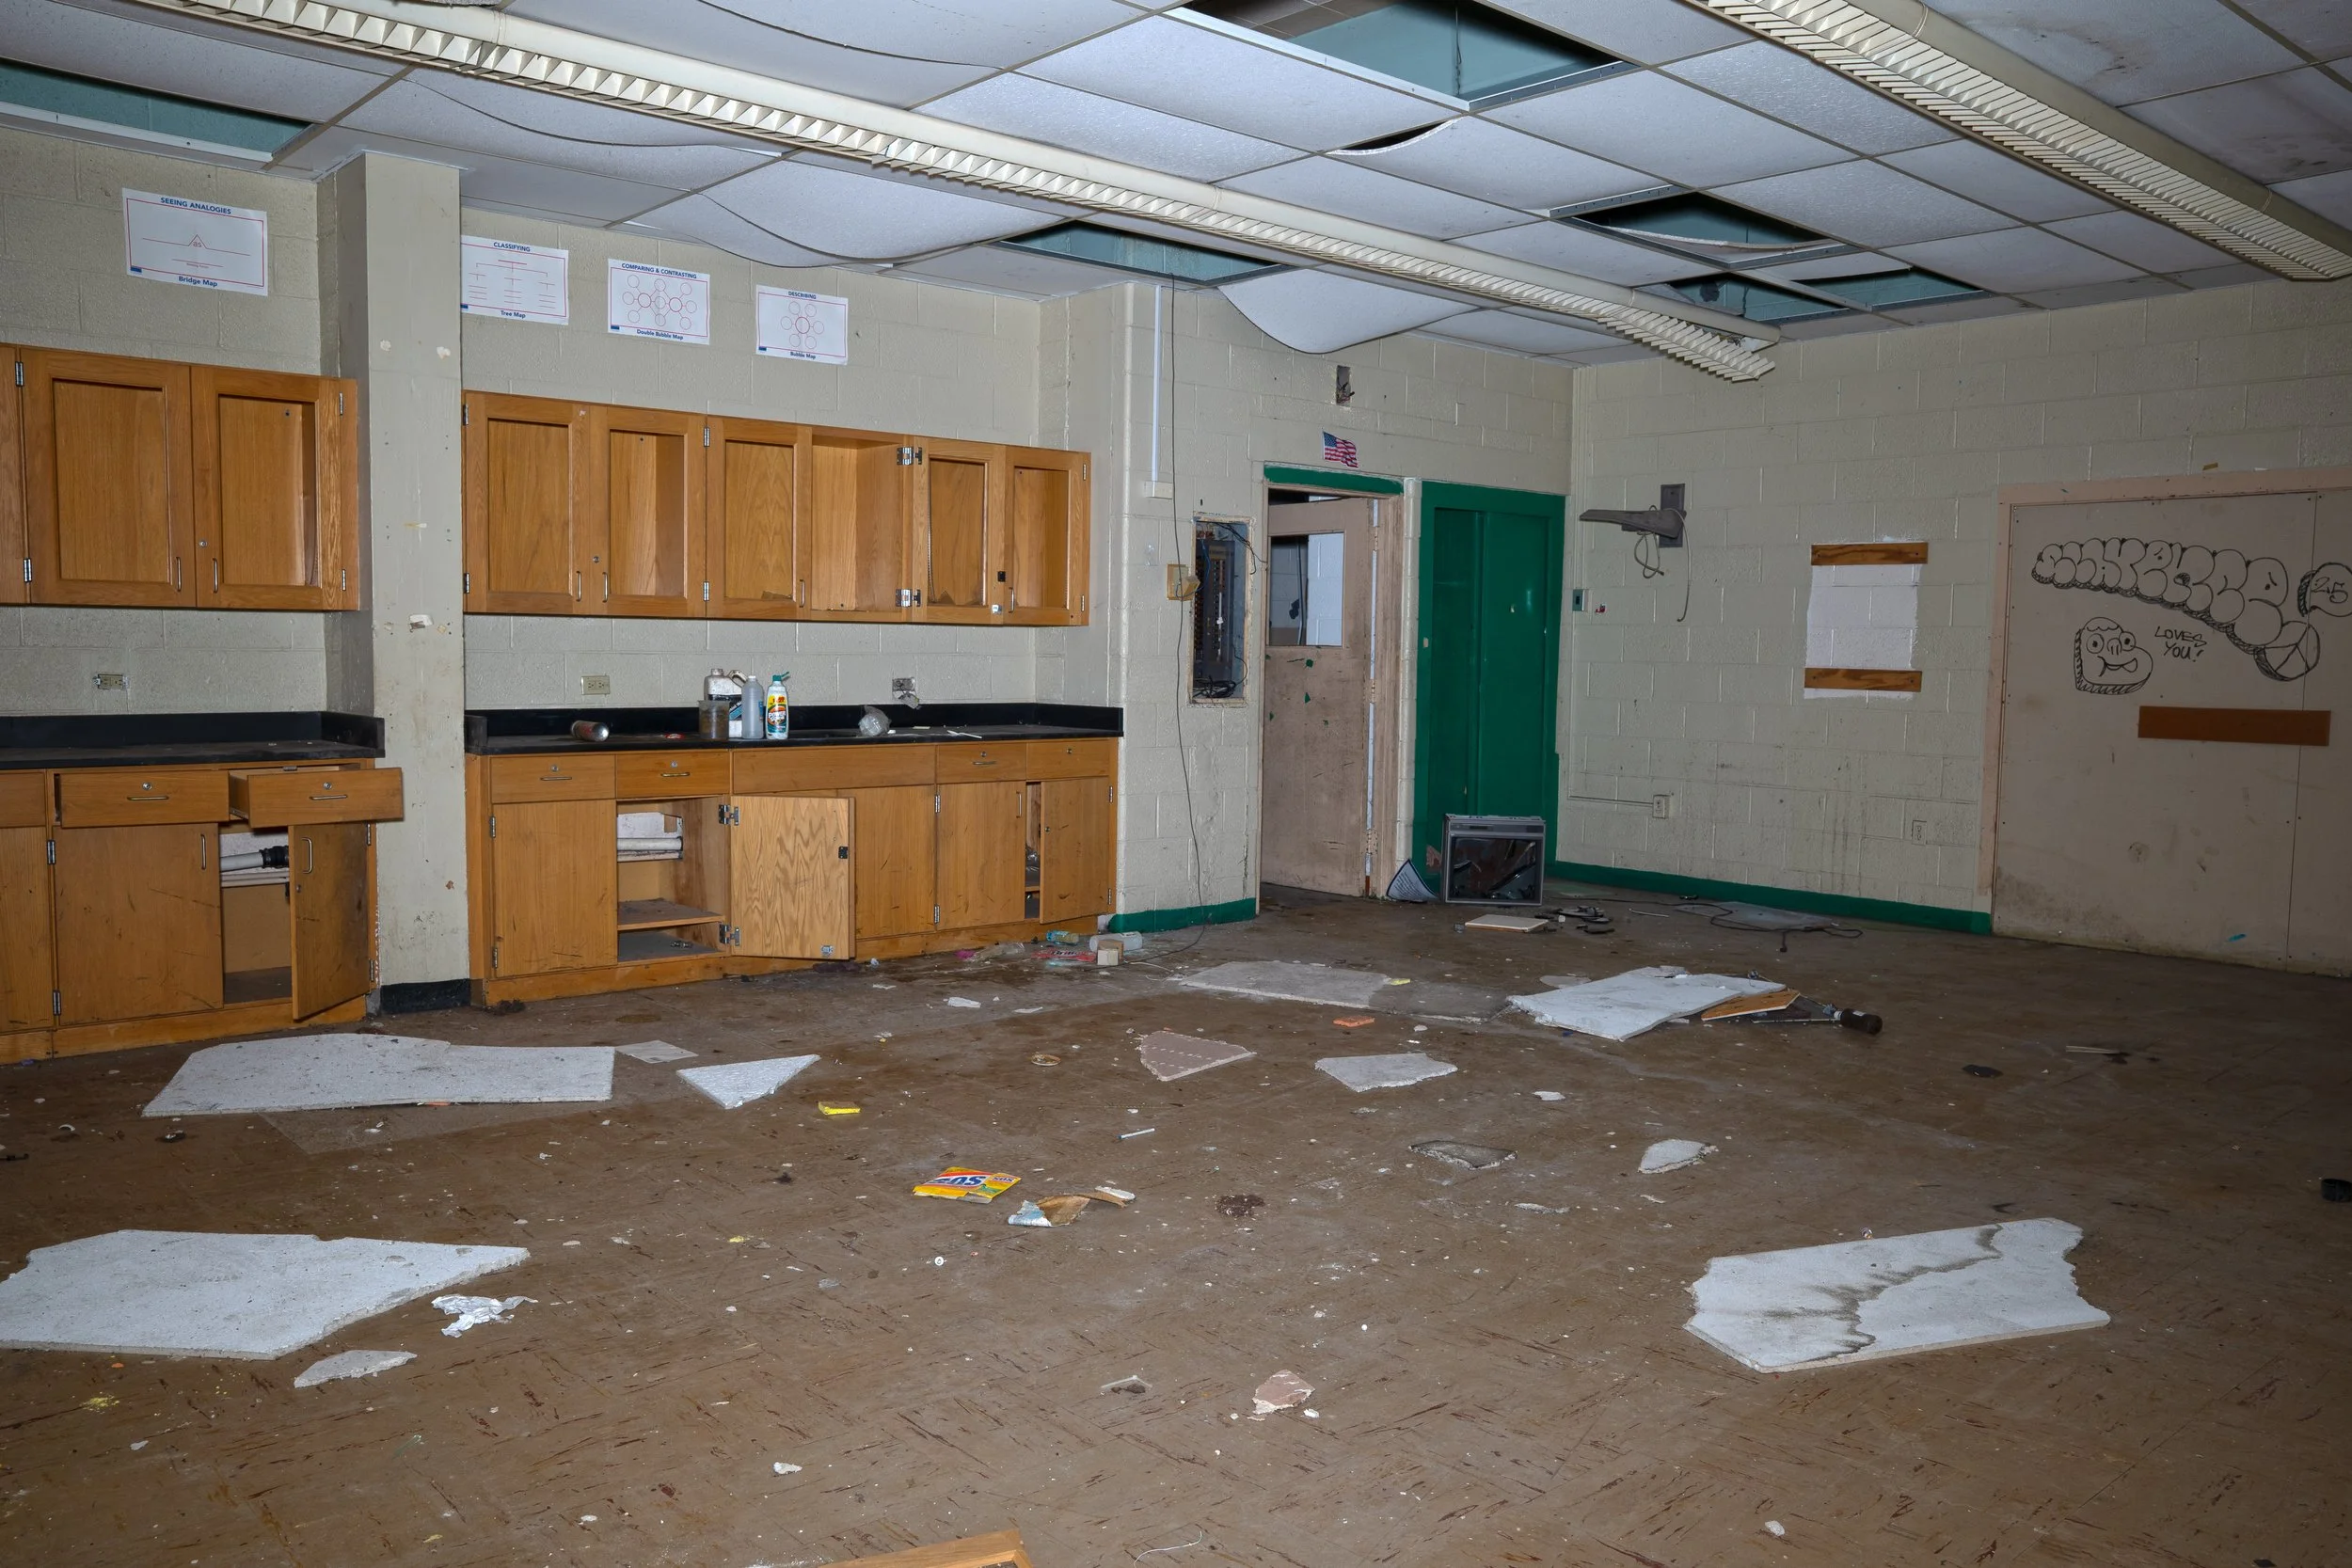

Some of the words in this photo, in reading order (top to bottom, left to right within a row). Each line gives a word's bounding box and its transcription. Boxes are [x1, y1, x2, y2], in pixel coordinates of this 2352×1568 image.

[160, 198, 187, 207] SEEING
[189, 201, 231, 214] ANALOGIES
[493, 242, 531, 252] CLASSIFYING
[621, 262, 655, 273] COMPARING
[660, 268, 697, 279] CONTRASTING
[178, 277, 200, 285] Bridge
[203, 277, 217, 287] Map
[787, 291, 817, 300] DESCRIBING
[2154, 626, 2207, 648] LOVES
[2164, 641, 2204, 662] YOU!
